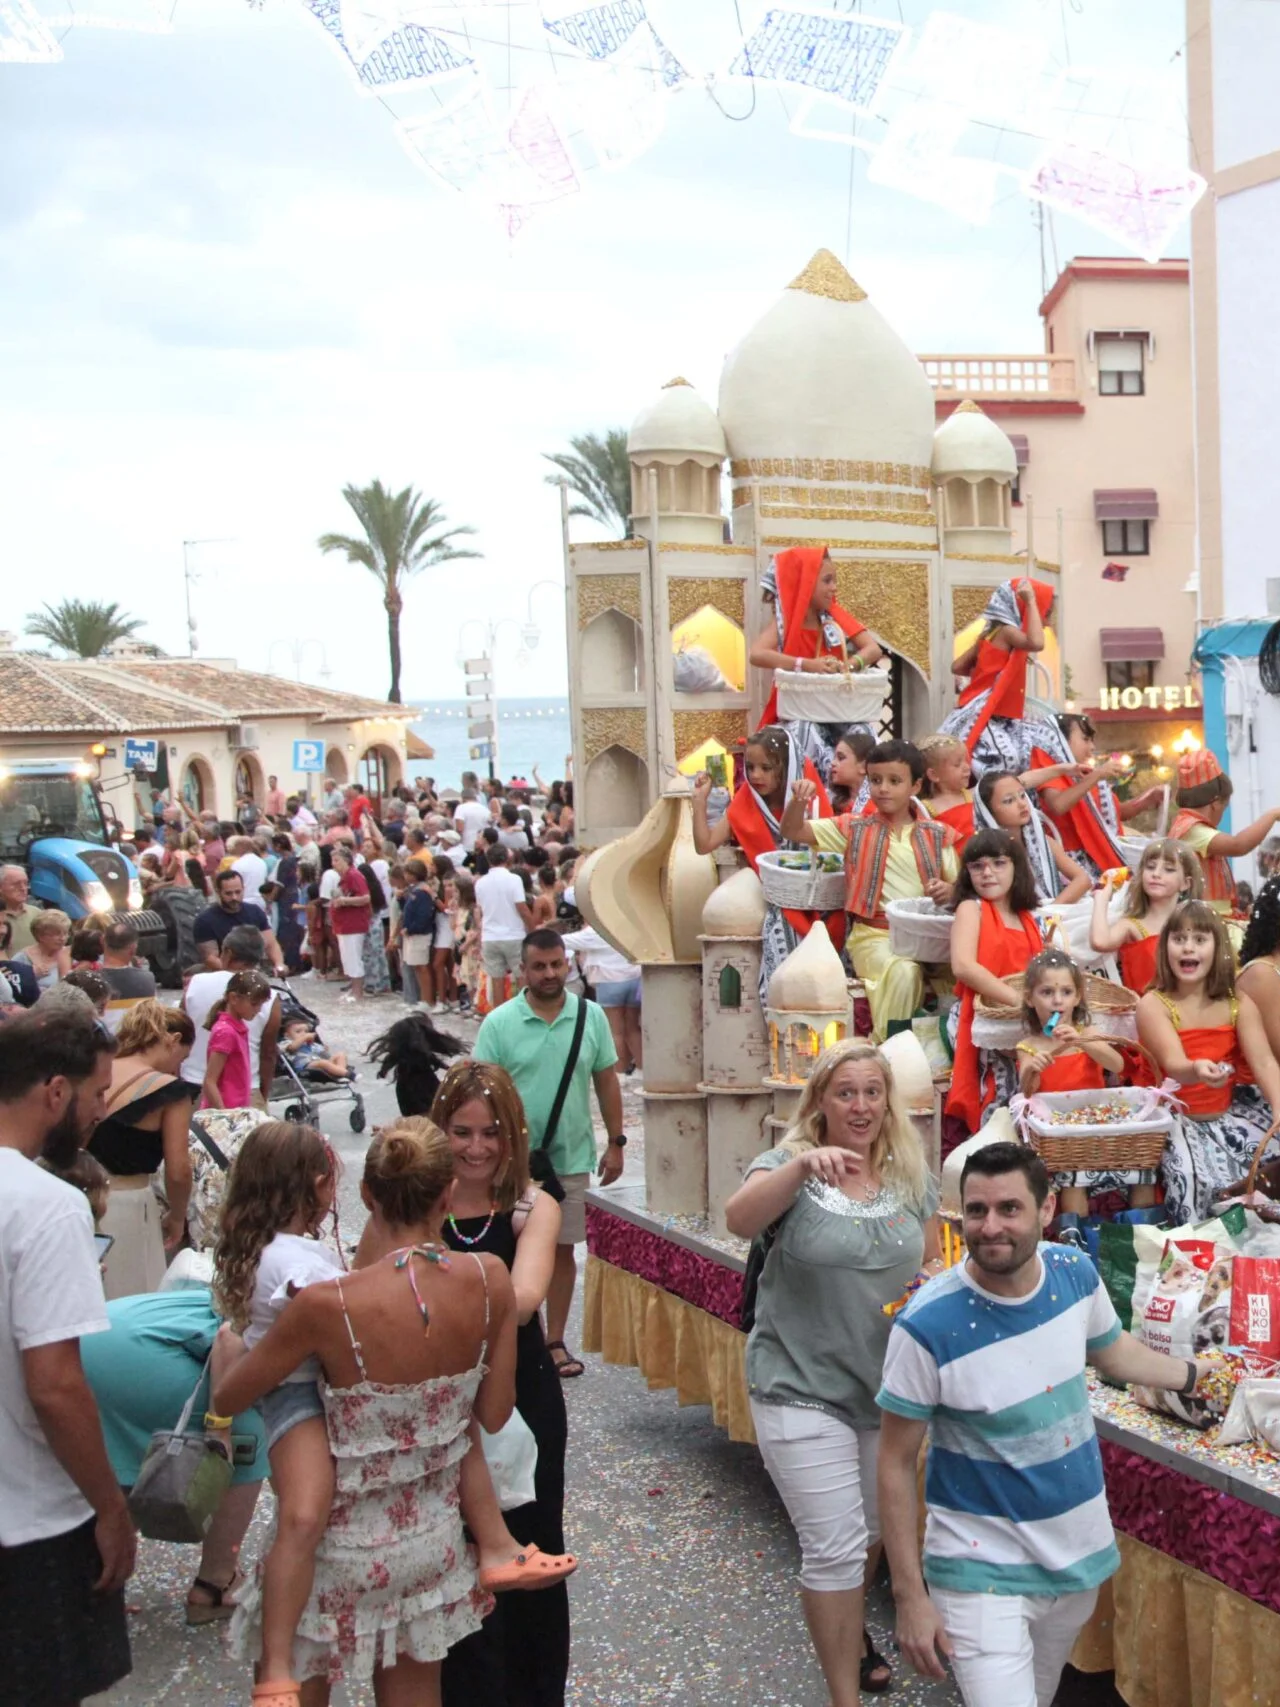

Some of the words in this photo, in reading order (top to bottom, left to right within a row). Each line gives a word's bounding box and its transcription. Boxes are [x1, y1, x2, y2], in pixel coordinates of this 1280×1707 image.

[1099, 685, 1200, 711] HOTEL
[127, 749, 154, 760] TAXI
[298, 743, 318, 768] P
